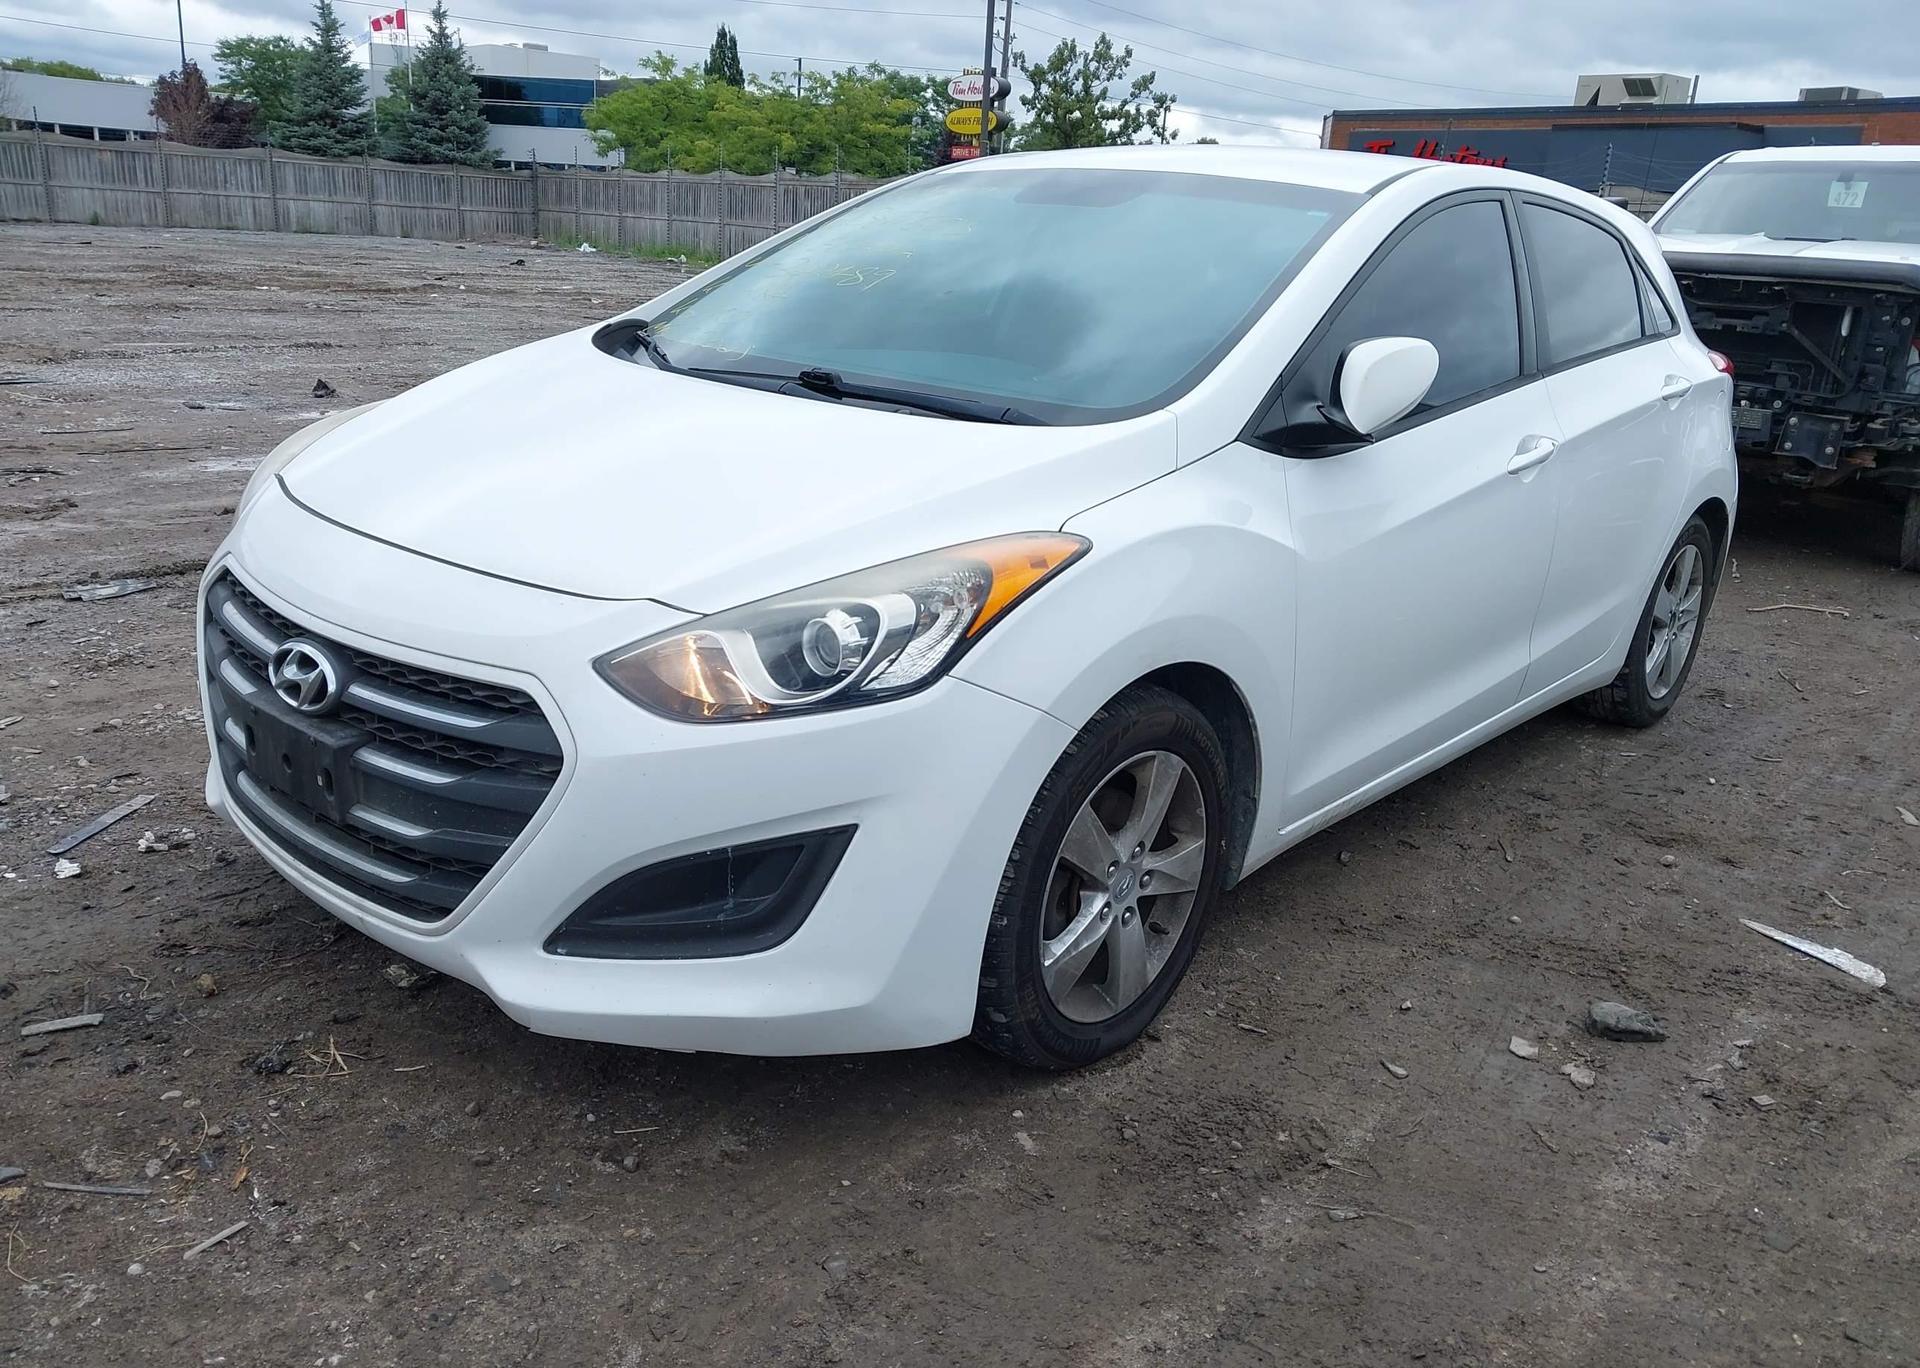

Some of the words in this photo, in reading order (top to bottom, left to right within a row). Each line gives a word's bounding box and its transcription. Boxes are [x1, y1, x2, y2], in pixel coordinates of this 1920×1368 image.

[952, 81, 966, 95] Tim
[950, 117, 971, 125] ALWAYS
[953, 148, 969, 156] DRIVE
